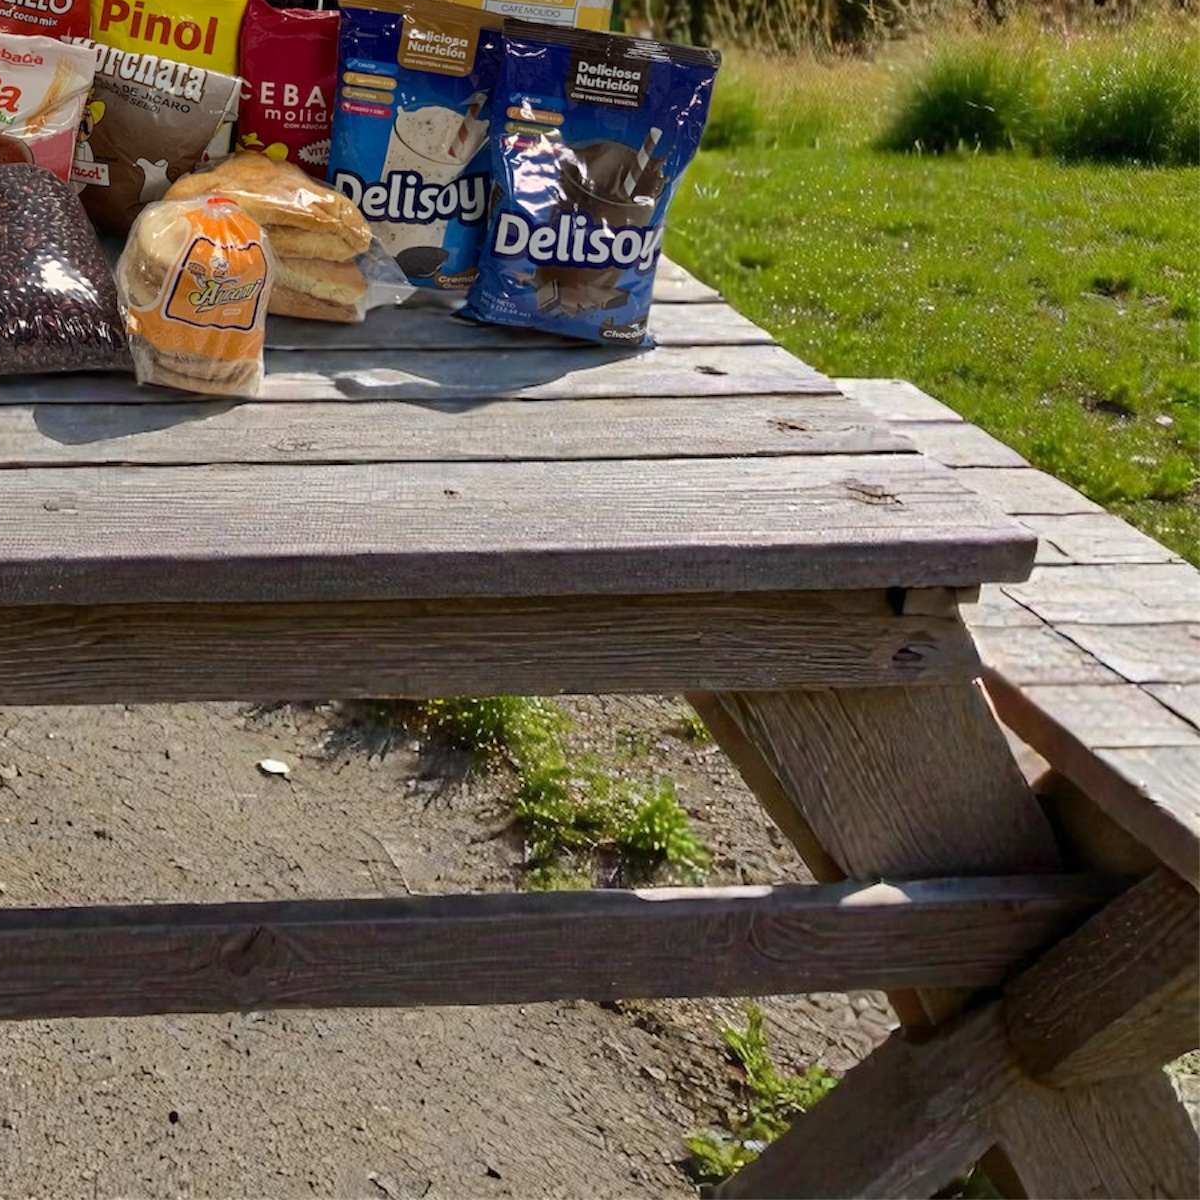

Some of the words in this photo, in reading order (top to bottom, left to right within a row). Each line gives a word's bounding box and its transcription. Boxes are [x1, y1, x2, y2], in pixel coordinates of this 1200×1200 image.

[13, 11, 38, 24] cocoa
[39, 17, 59, 27] mix
[500, 2, 524, 15] CAFÉ
[524, 6, 561, 18] MOLIDO
[409, 28, 469, 48] Deliciosa
[407, 40, 467, 60] Nutrición
[578, 60, 642, 82] Deliciosa
[122, 84, 140, 98] DE
[576, 73, 640, 94] Nutrición
[283, 122, 301, 130] CON
[335, 172, 486, 222] Delisoy
[494, 213, 664, 271] Delisoy
